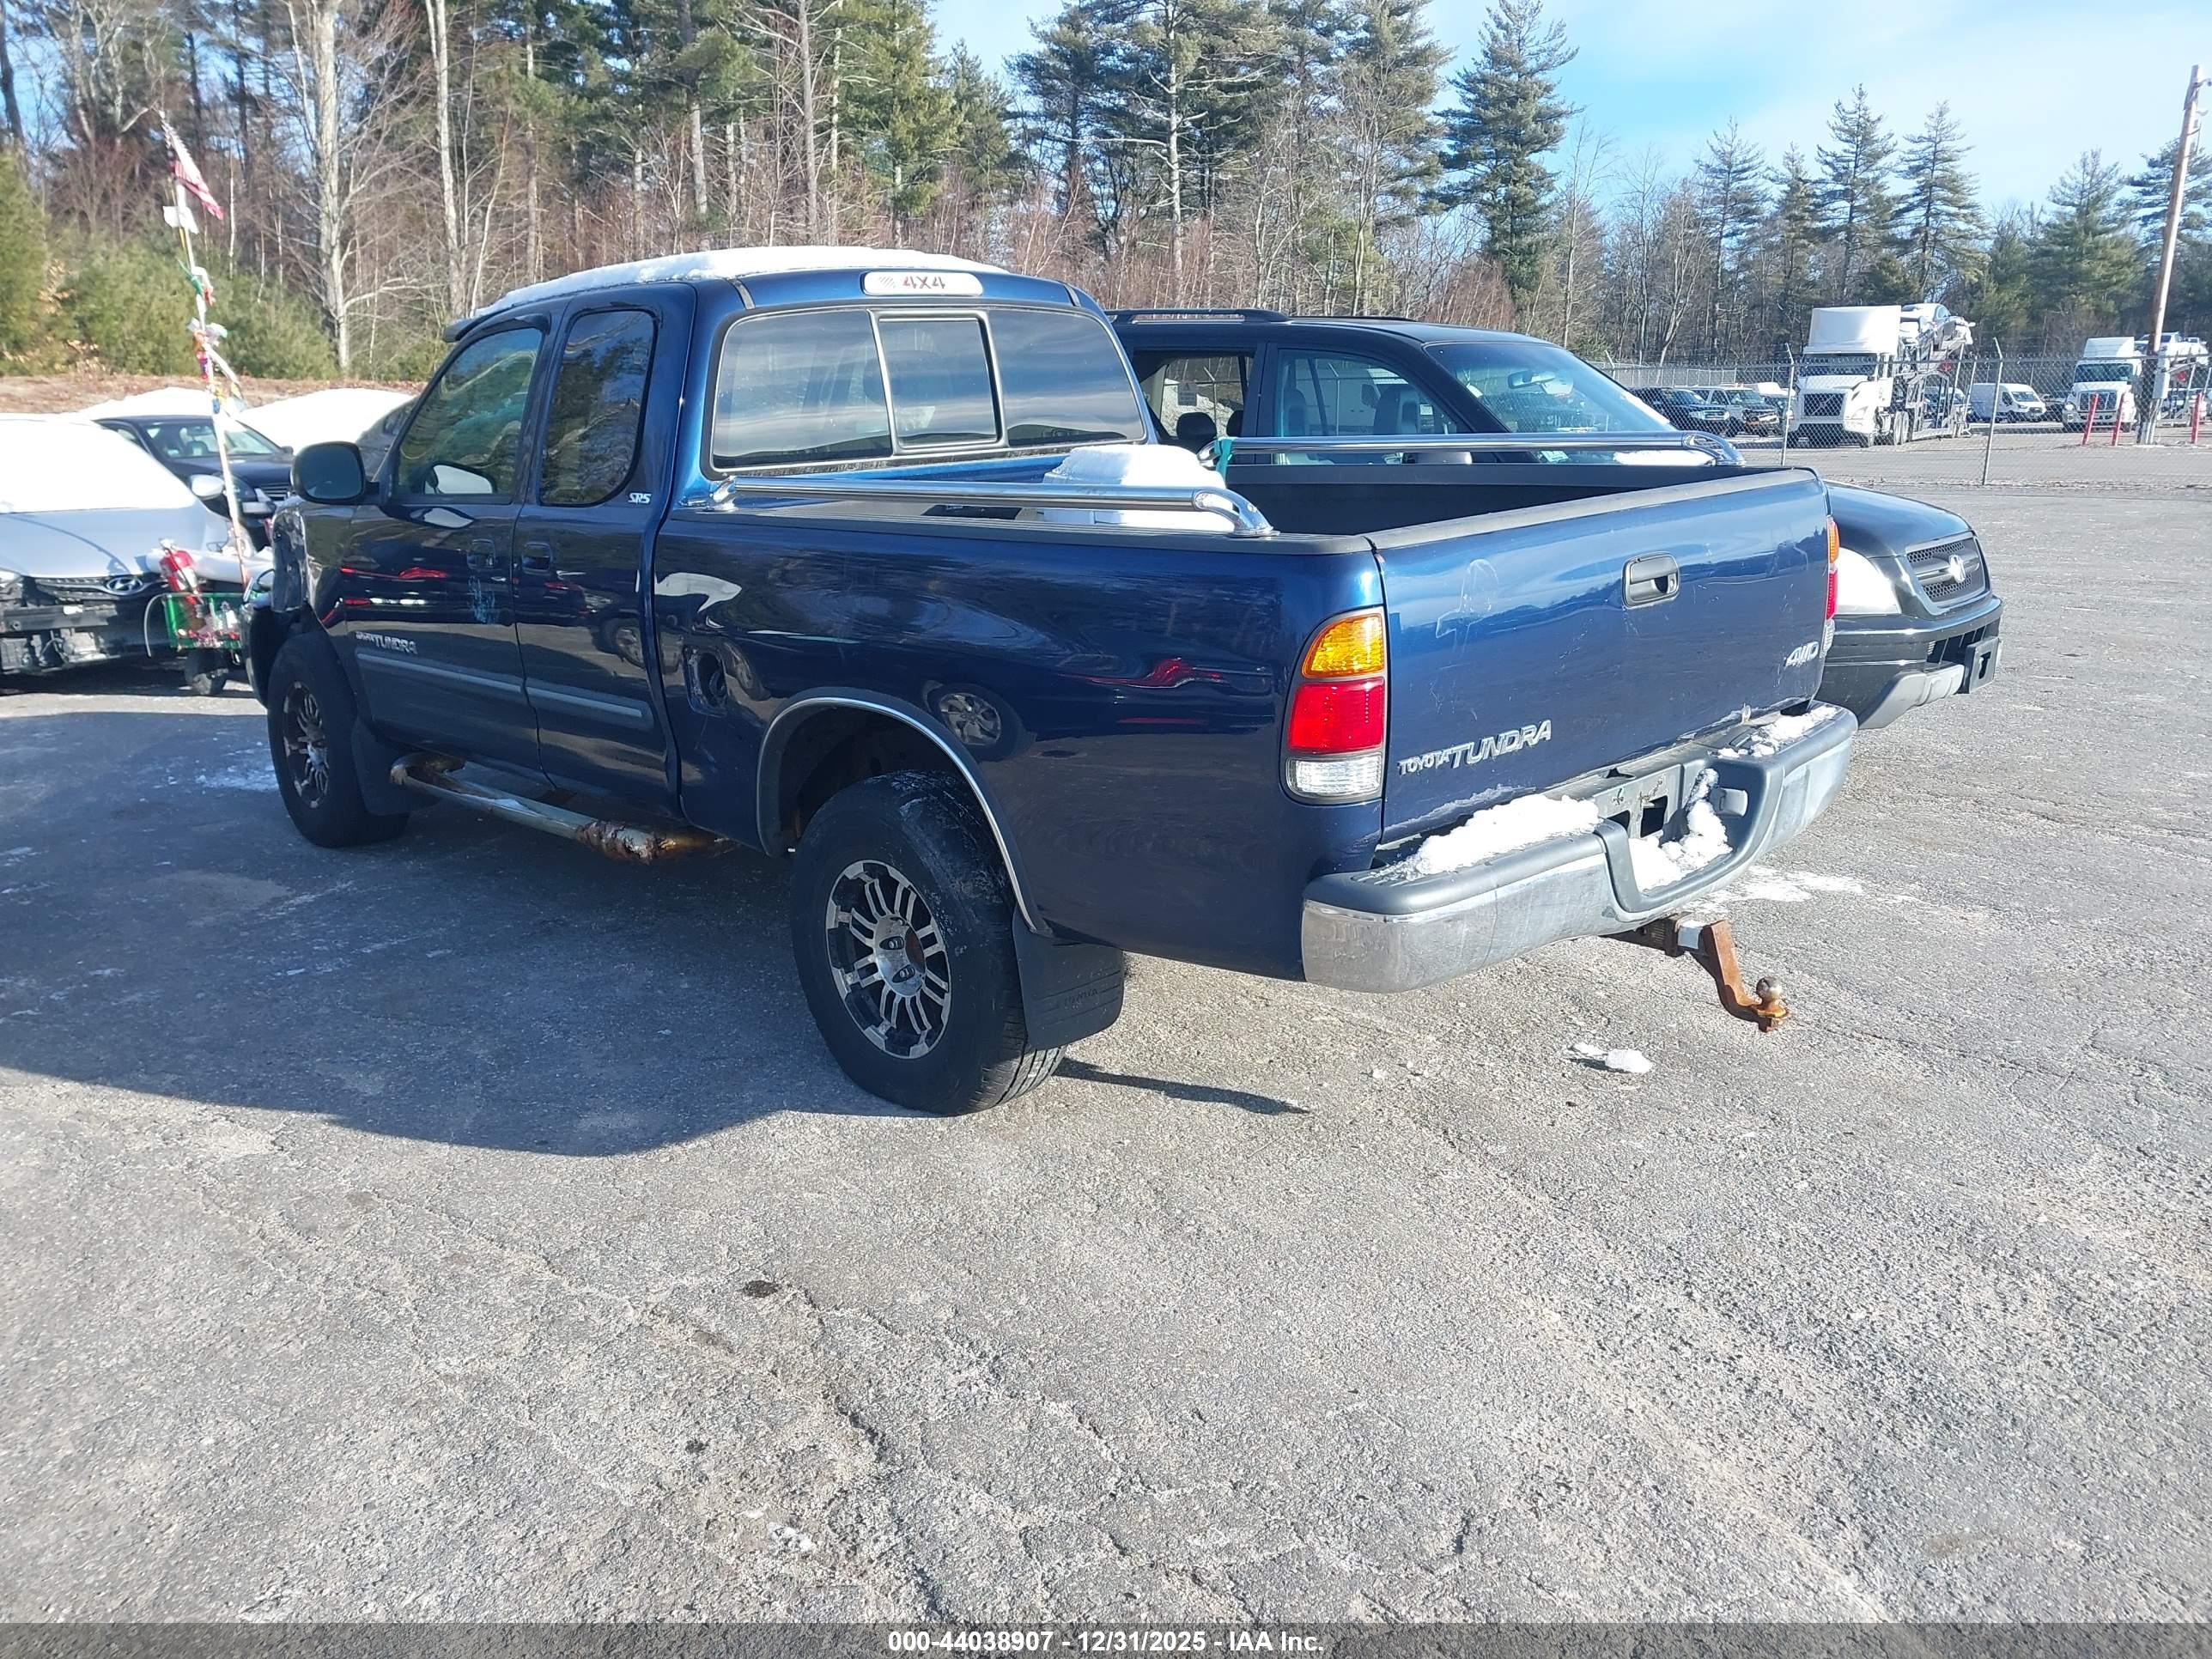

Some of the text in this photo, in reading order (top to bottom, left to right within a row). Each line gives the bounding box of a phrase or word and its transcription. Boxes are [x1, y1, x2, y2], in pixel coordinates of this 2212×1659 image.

[902, 276, 945, 289] 4X4
[628, 492, 652, 504] SR5
[372, 634, 418, 654] TUNDRA
[1785, 641, 1820, 667] 4WD
[1397, 719, 1553, 775] TOYOTA TUNDRA
